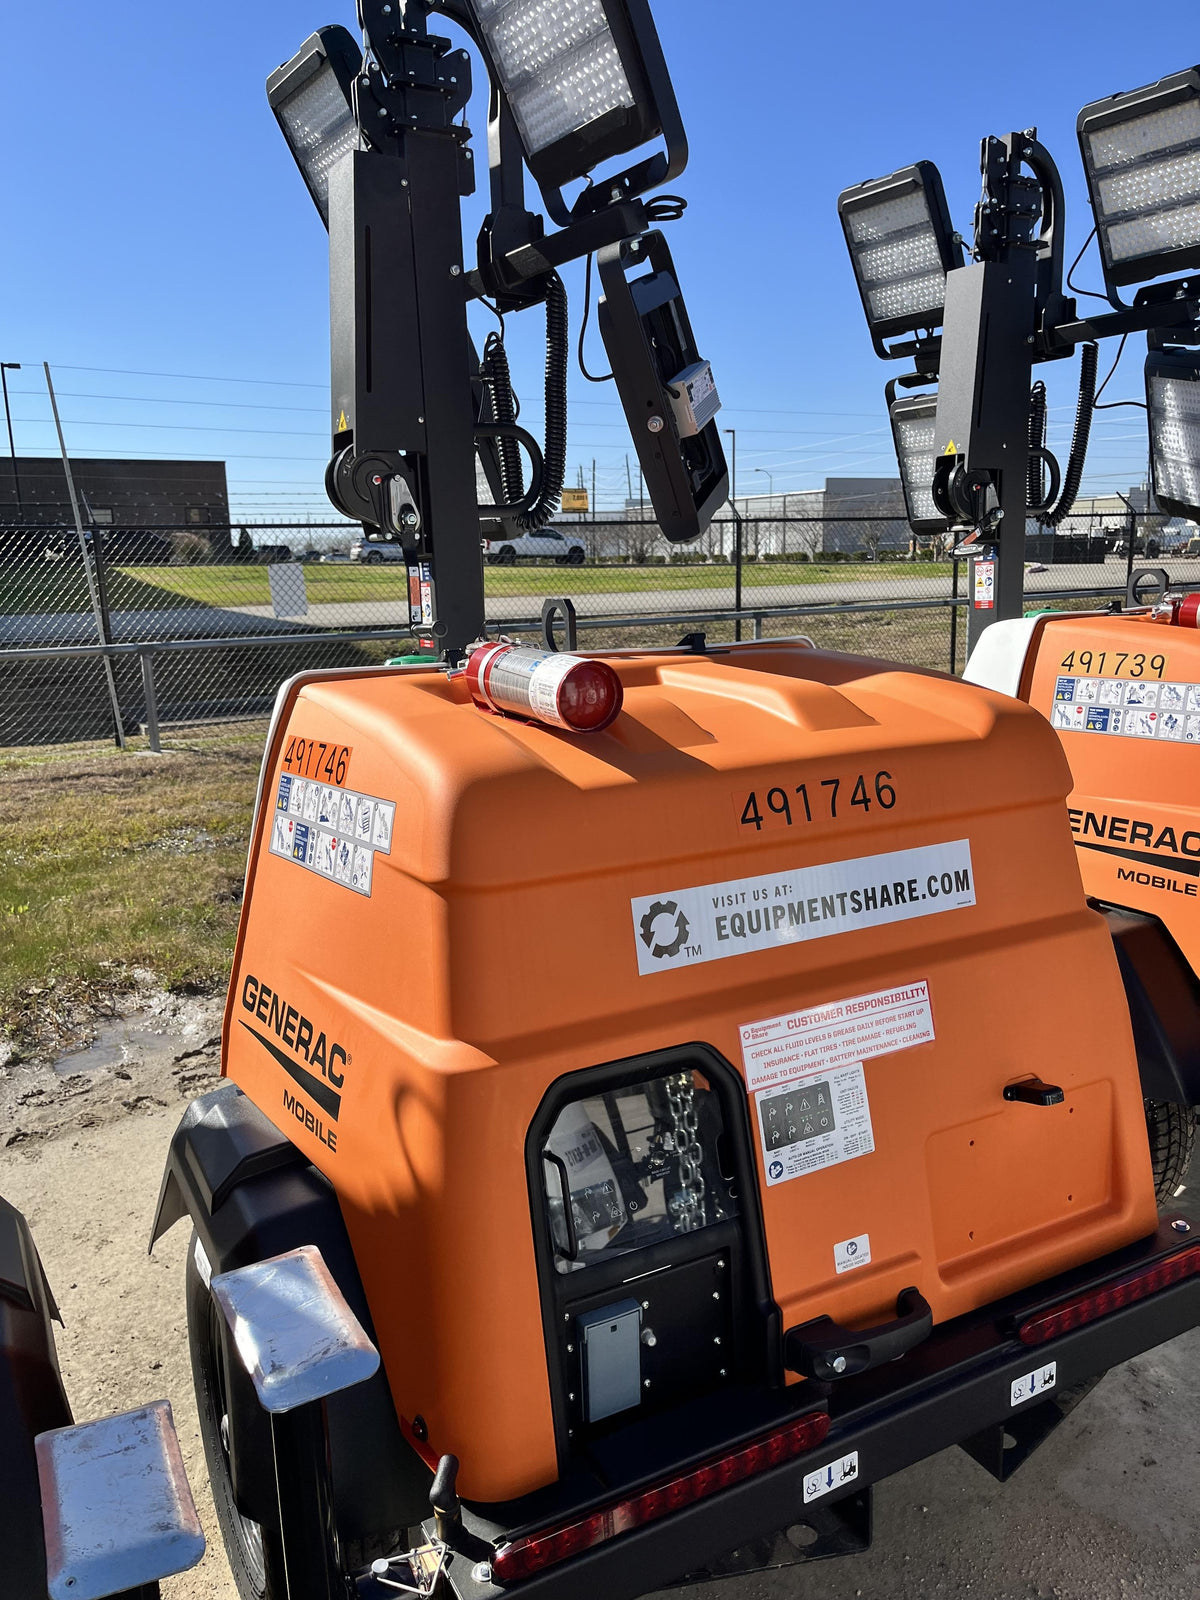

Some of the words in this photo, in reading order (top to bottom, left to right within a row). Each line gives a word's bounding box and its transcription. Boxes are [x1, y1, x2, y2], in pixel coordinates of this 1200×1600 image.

[1061, 650, 1167, 679] 491739
[284, 737, 349, 785] 491746
[740, 770, 897, 831] 491746
[1067, 808, 1200, 857] ENERAC
[712, 892, 747, 909] VISIT
[752, 888, 768, 901] US
[774, 884, 793, 899] AT:
[715, 869, 971, 941] EQUIPMENTSHARE.COM
[1117, 867, 1198, 896] MOBILE
[684, 944, 702, 958] TM
[242, 974, 347, 1089] GENERAC
[751, 1022, 782, 1034] Equipment
[787, 1007, 843, 1030] CUSTOMER
[845, 986, 926, 1015] RESPONSIBILITY
[751, 1048, 772, 1059] CHECK
[773, 1045, 785, 1054] ALL
[785, 1040, 804, 1051] FLUID
[805, 1033, 827, 1046] LEVELS
[832, 1026, 856, 1038] GREASE
[857, 1020, 874, 1031] DAILY
[875, 1015, 897, 1026] BEFORE
[898, 1011, 915, 1021] START
[916, 1008, 924, 1016] UP
[751, 1031, 768, 1040] Share
[763, 1055, 800, 1069] INSURANCE
[804, 1049, 818, 1058] FLAT
[819, 1043, 837, 1053] TIRES
[842, 1038, 856, 1047] TIRE
[856, 1032, 881, 1043] DAMAGE
[885, 1022, 917, 1035] REFUELING
[751, 1072, 778, 1085] DAMAGE
[779, 1070, 788, 1078] TO
[789, 1060, 825, 1075] EQUIPMENT
[829, 1052, 856, 1064] BATTERY
[856, 1040, 898, 1055] MAINTENANCE
[902, 1030, 931, 1043] CLEANING
[283, 1088, 338, 1154] MOBILE
